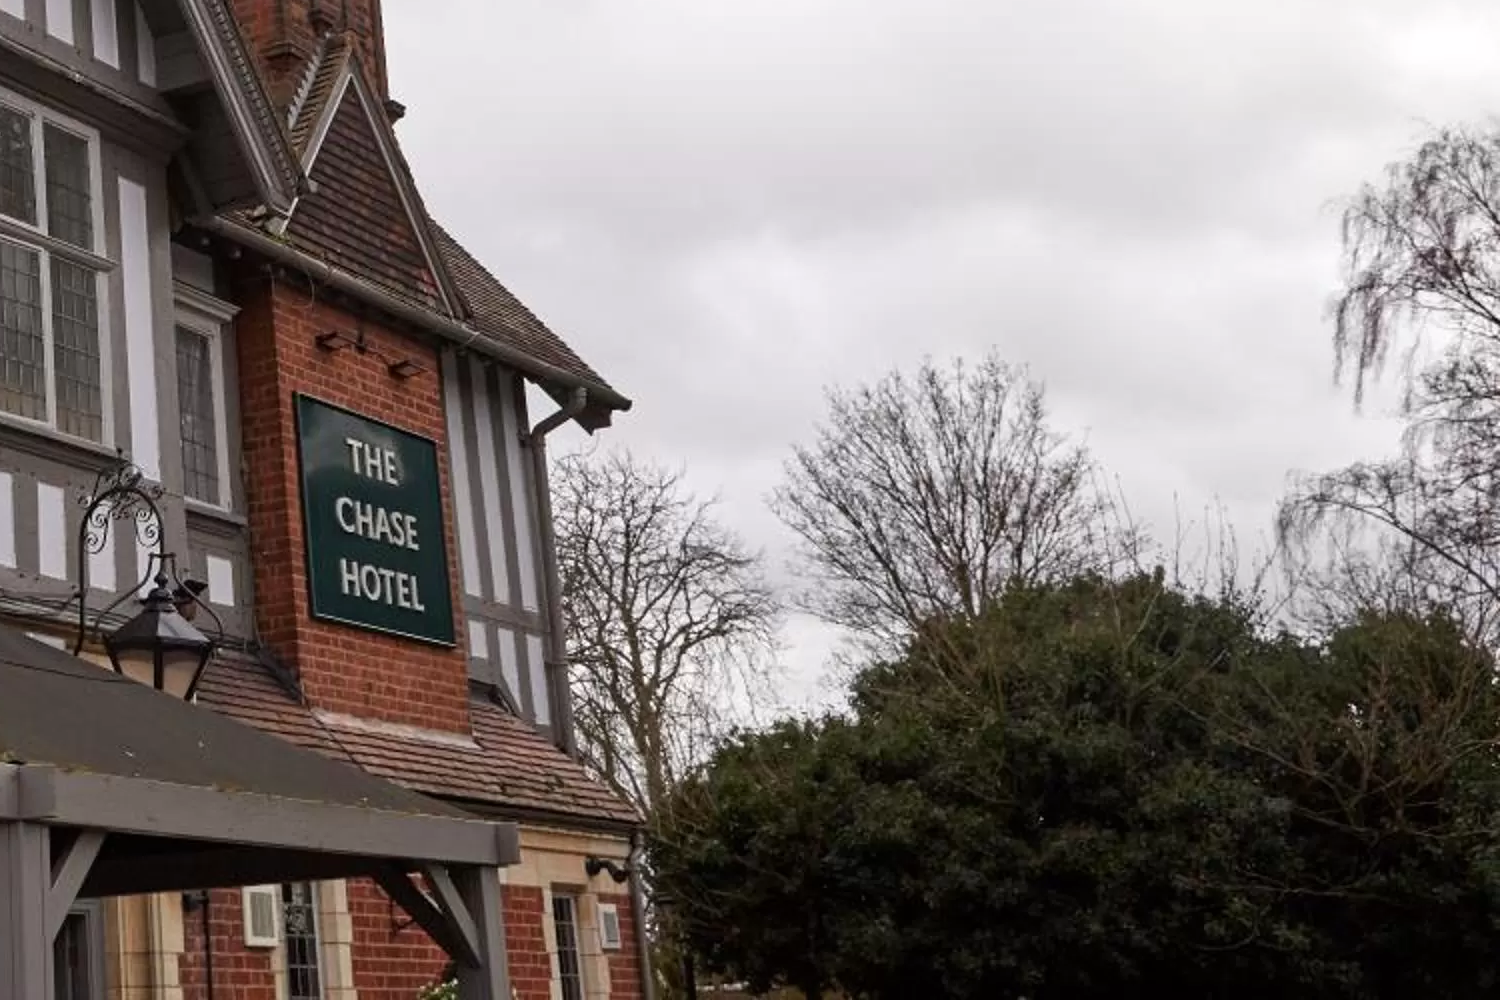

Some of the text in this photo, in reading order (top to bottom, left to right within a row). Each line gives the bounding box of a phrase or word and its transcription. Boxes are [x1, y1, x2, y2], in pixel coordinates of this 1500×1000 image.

[346, 437, 399, 487] THE
[335, 496, 420, 551] CHASE
[339, 558, 425, 612] HOTEL
